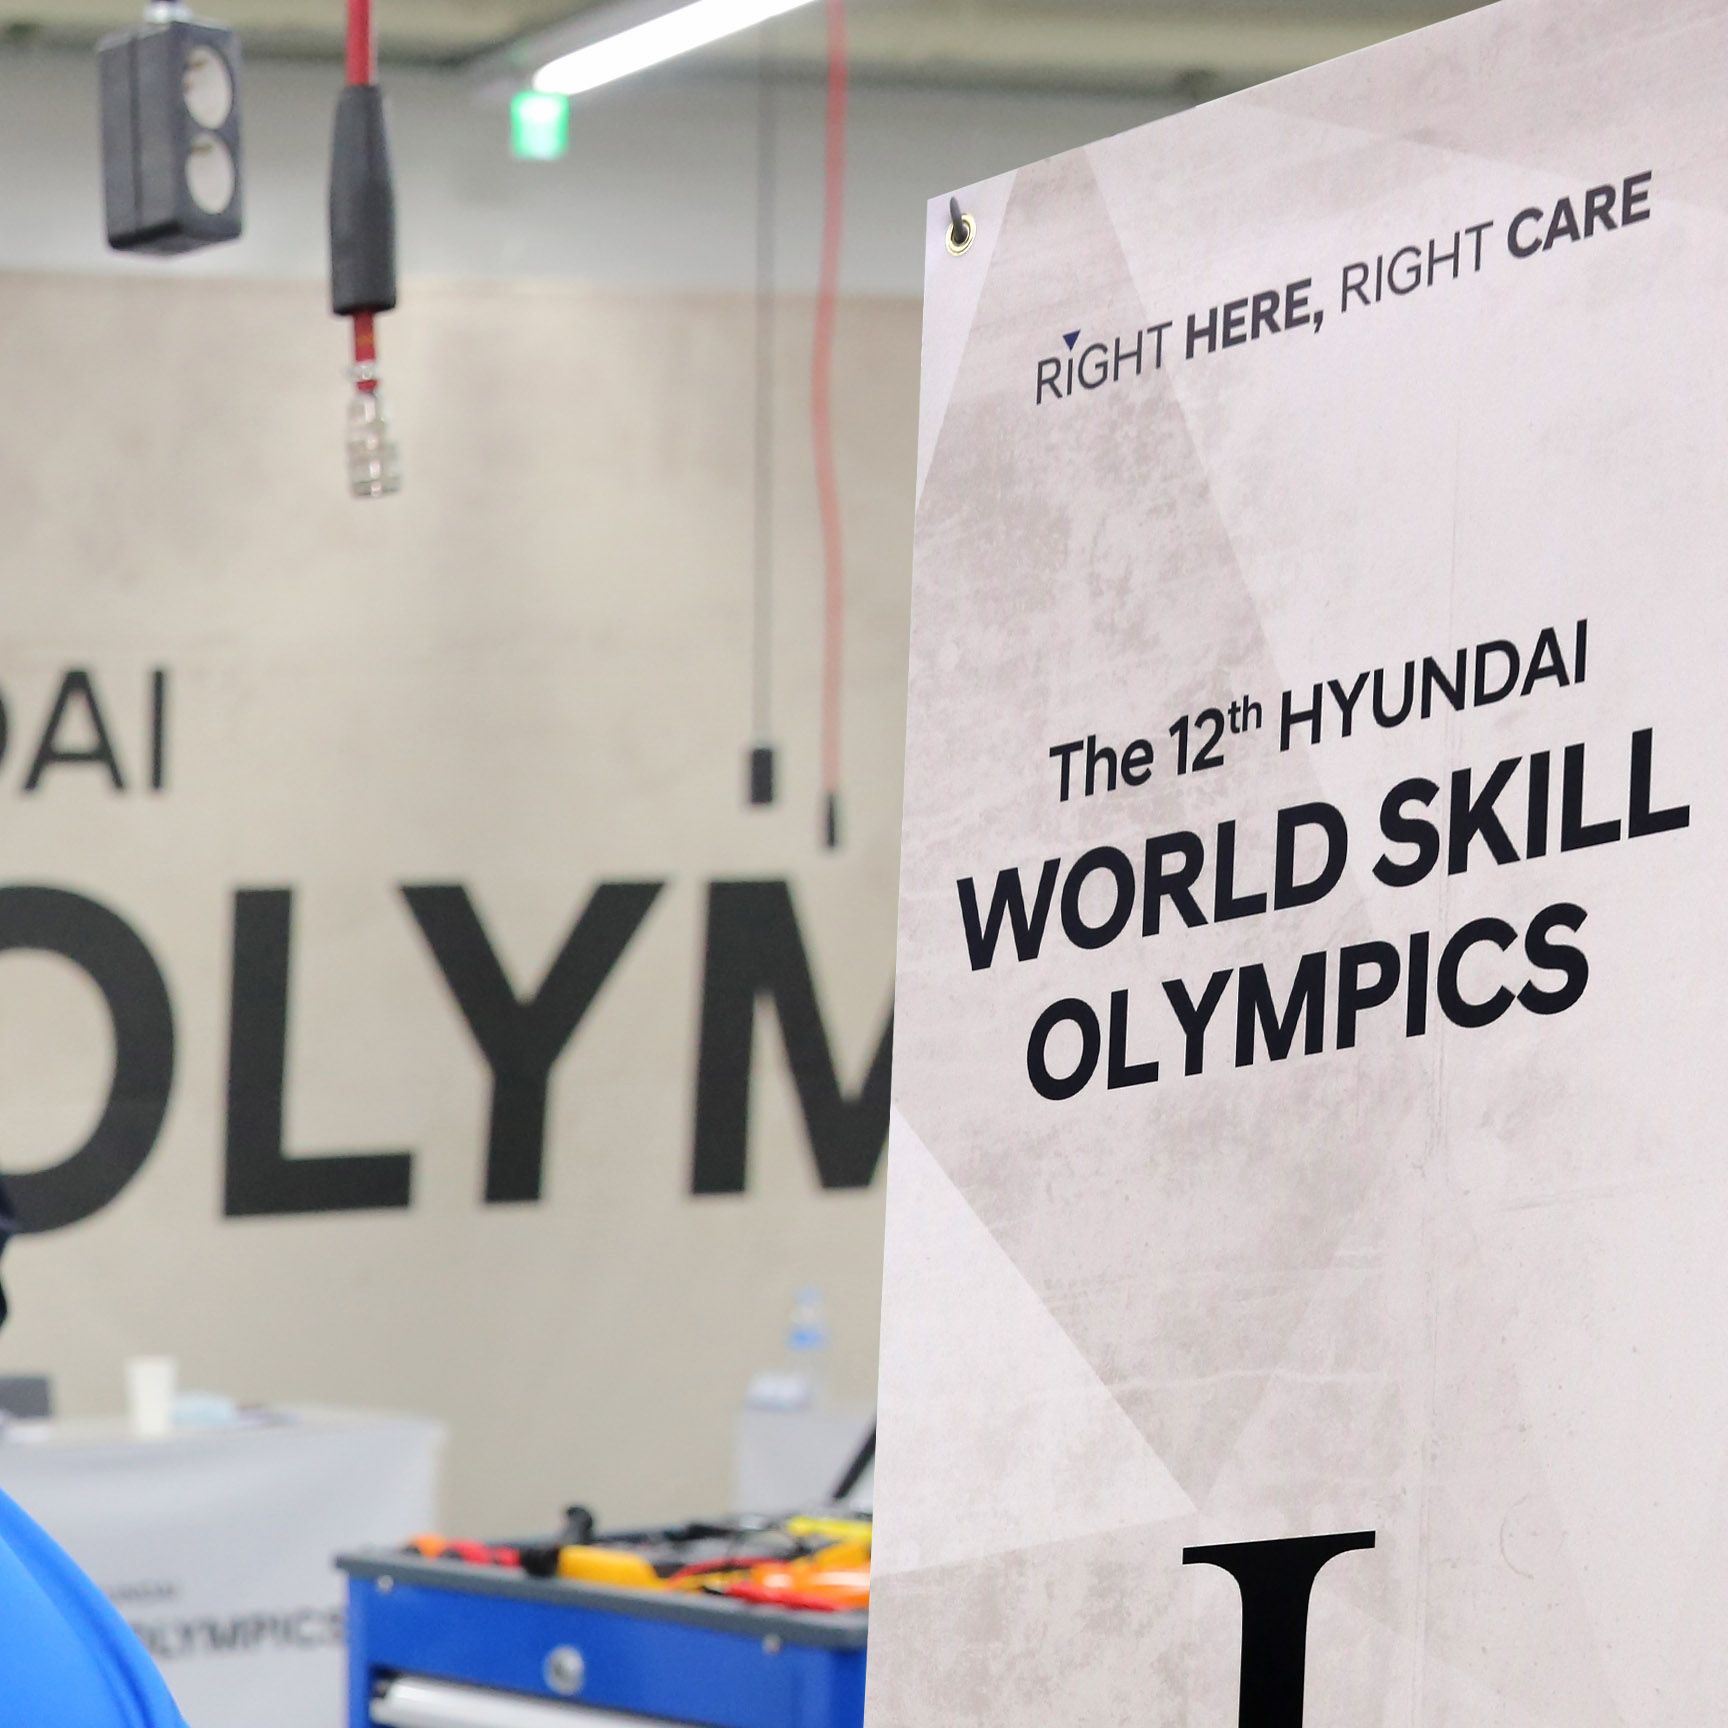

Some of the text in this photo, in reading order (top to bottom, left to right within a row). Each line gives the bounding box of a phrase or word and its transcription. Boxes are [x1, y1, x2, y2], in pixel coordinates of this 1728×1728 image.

[1036, 171, 1652, 405] RIGHT HERE, RIGHT CARE
[1049, 618, 1588, 801] The 12th HYUNDAI
[956, 727, 1690, 972] WORLD SKILL
[1026, 902, 1590, 1101] OLYMPICS
